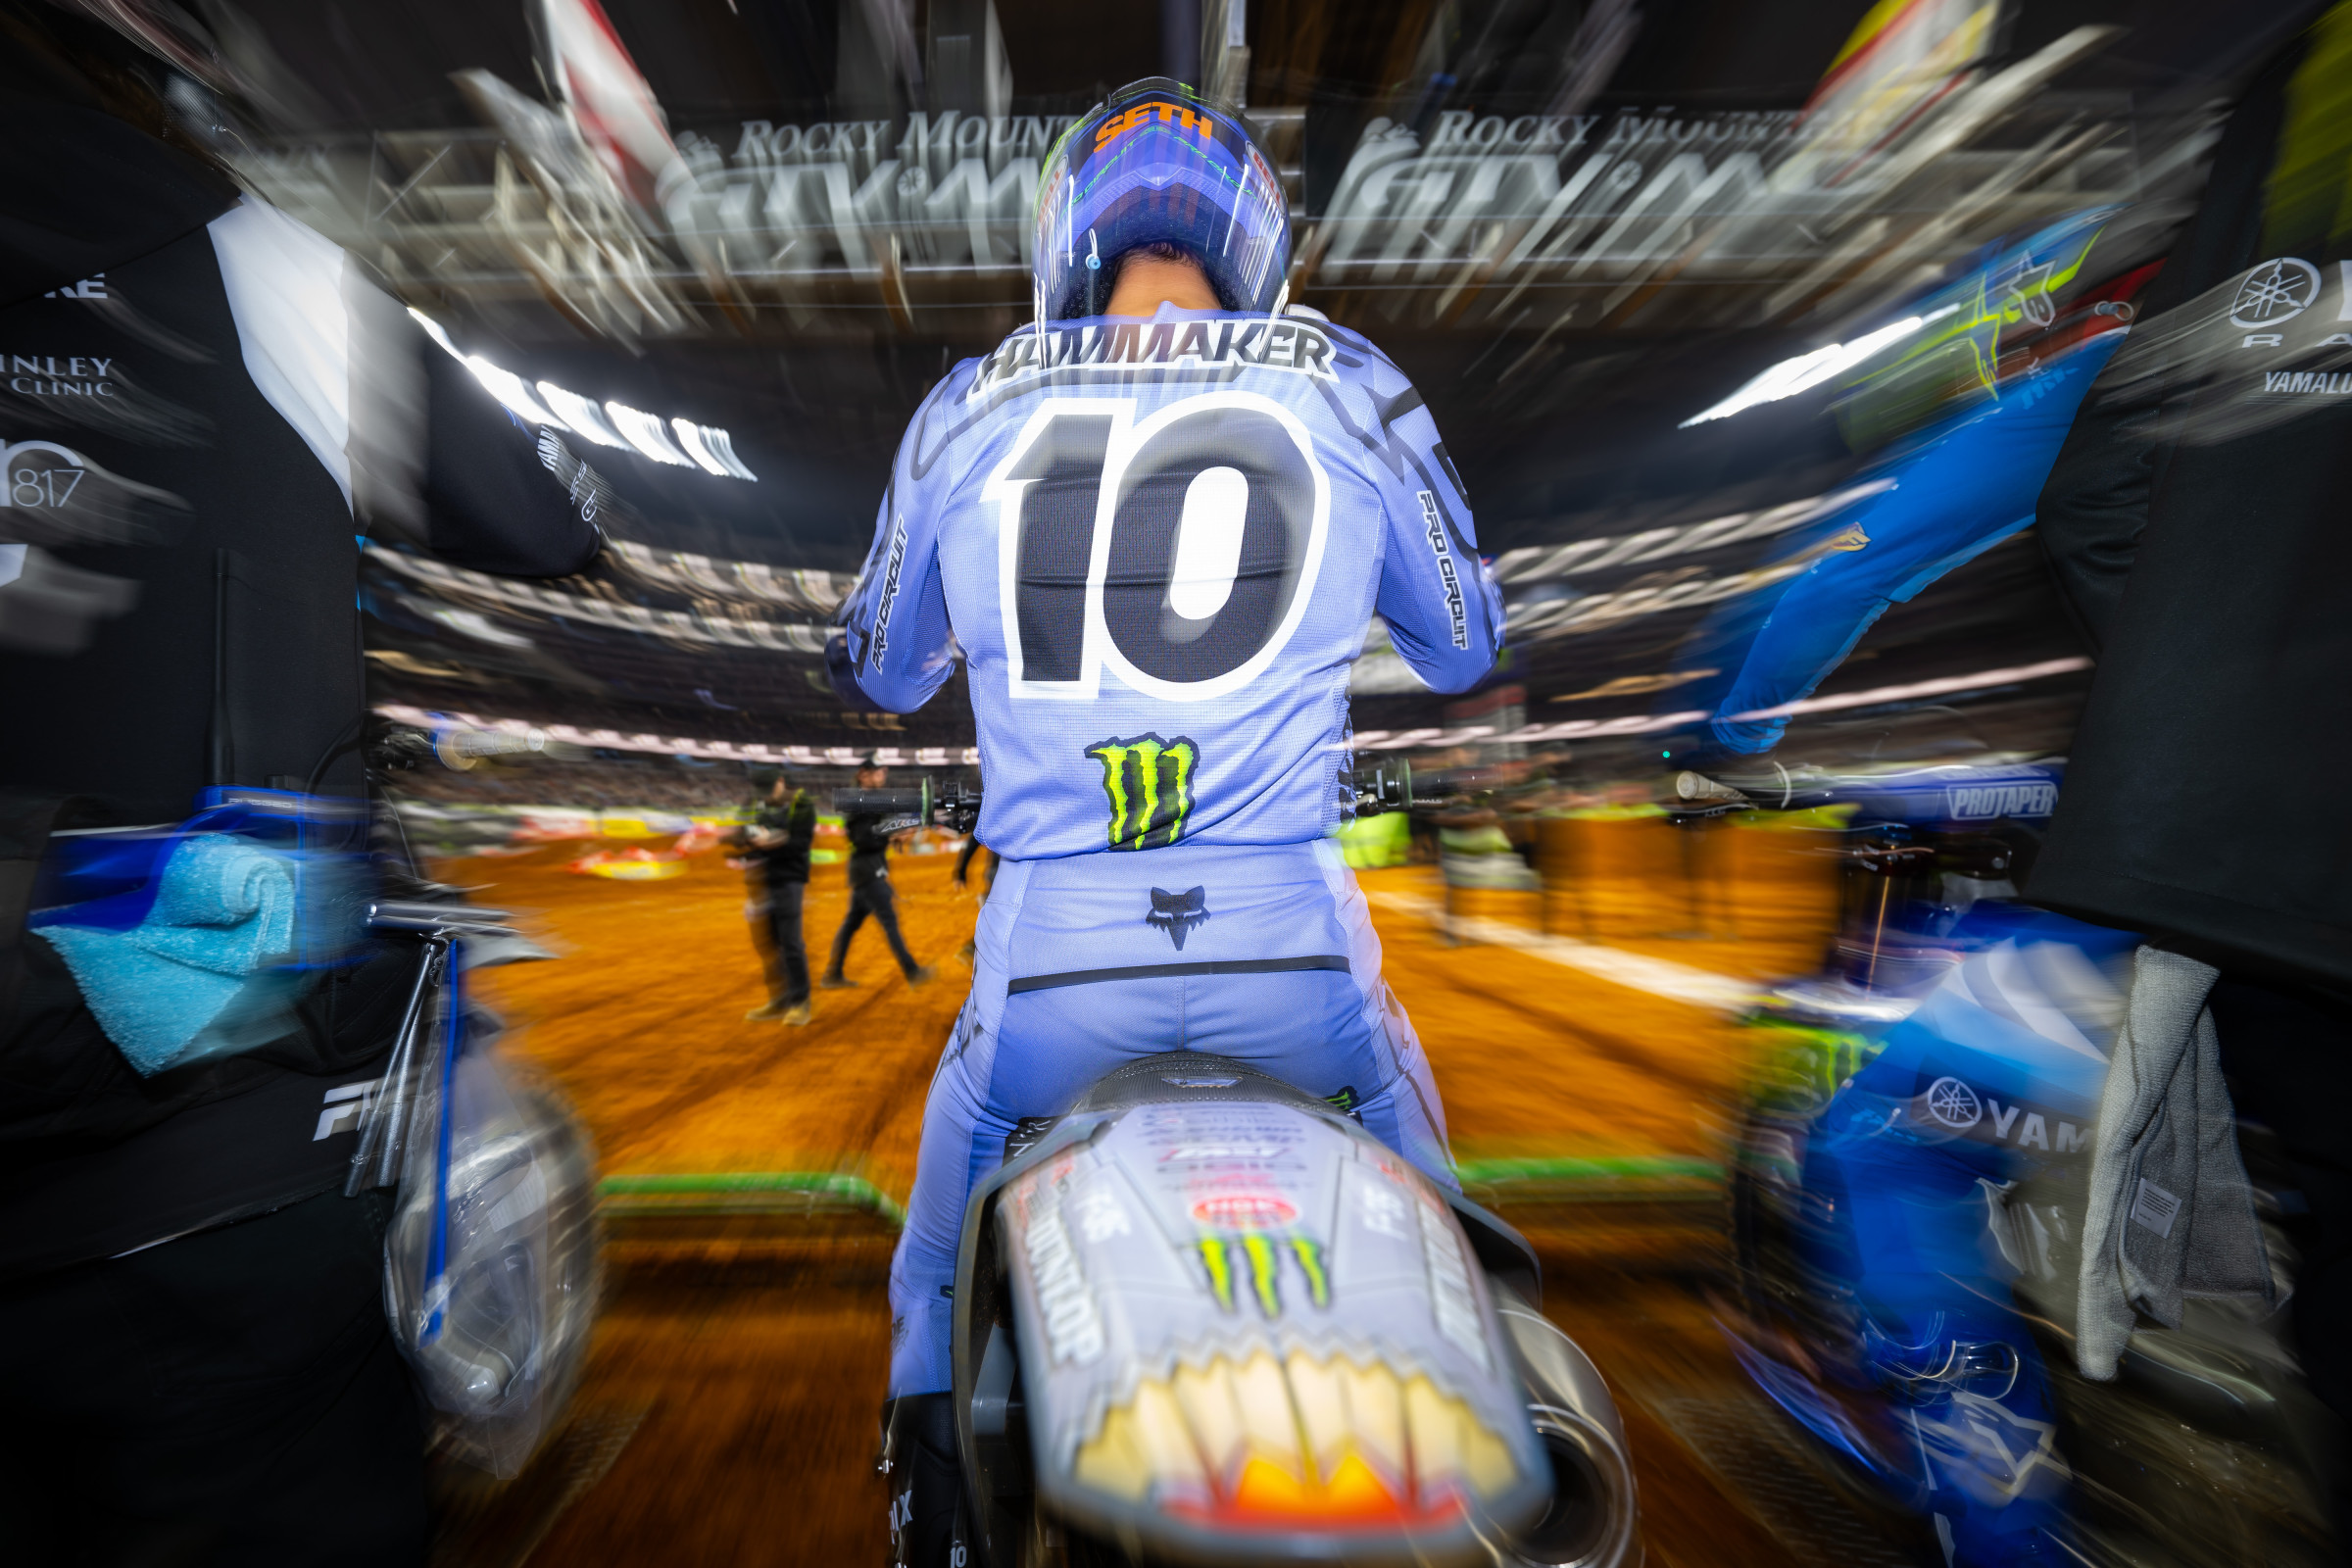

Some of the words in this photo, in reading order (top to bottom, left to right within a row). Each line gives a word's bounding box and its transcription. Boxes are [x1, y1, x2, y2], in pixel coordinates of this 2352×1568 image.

[732, 119, 892, 160] ROCKY
[1093, 101, 1213, 154] SETH
[1432, 109, 1601, 147] ROCKY
[1253, 152, 1281, 205] BELL
[968, 320, 1335, 396] HAMMAKER
[11, 377, 115, 398] CLINIC
[13, 468, 86, 508] 817
[992, 398, 1323, 692] 10
[1419, 491, 1446, 554] PRO
[1438, 557, 1468, 651] CIRCUIT
[878, 516, 907, 628] CIRCUIT
[871, 621, 887, 673] PRO
[1954, 785, 2056, 816] PROTAPER
[950, 1545, 967, 1568] 10
